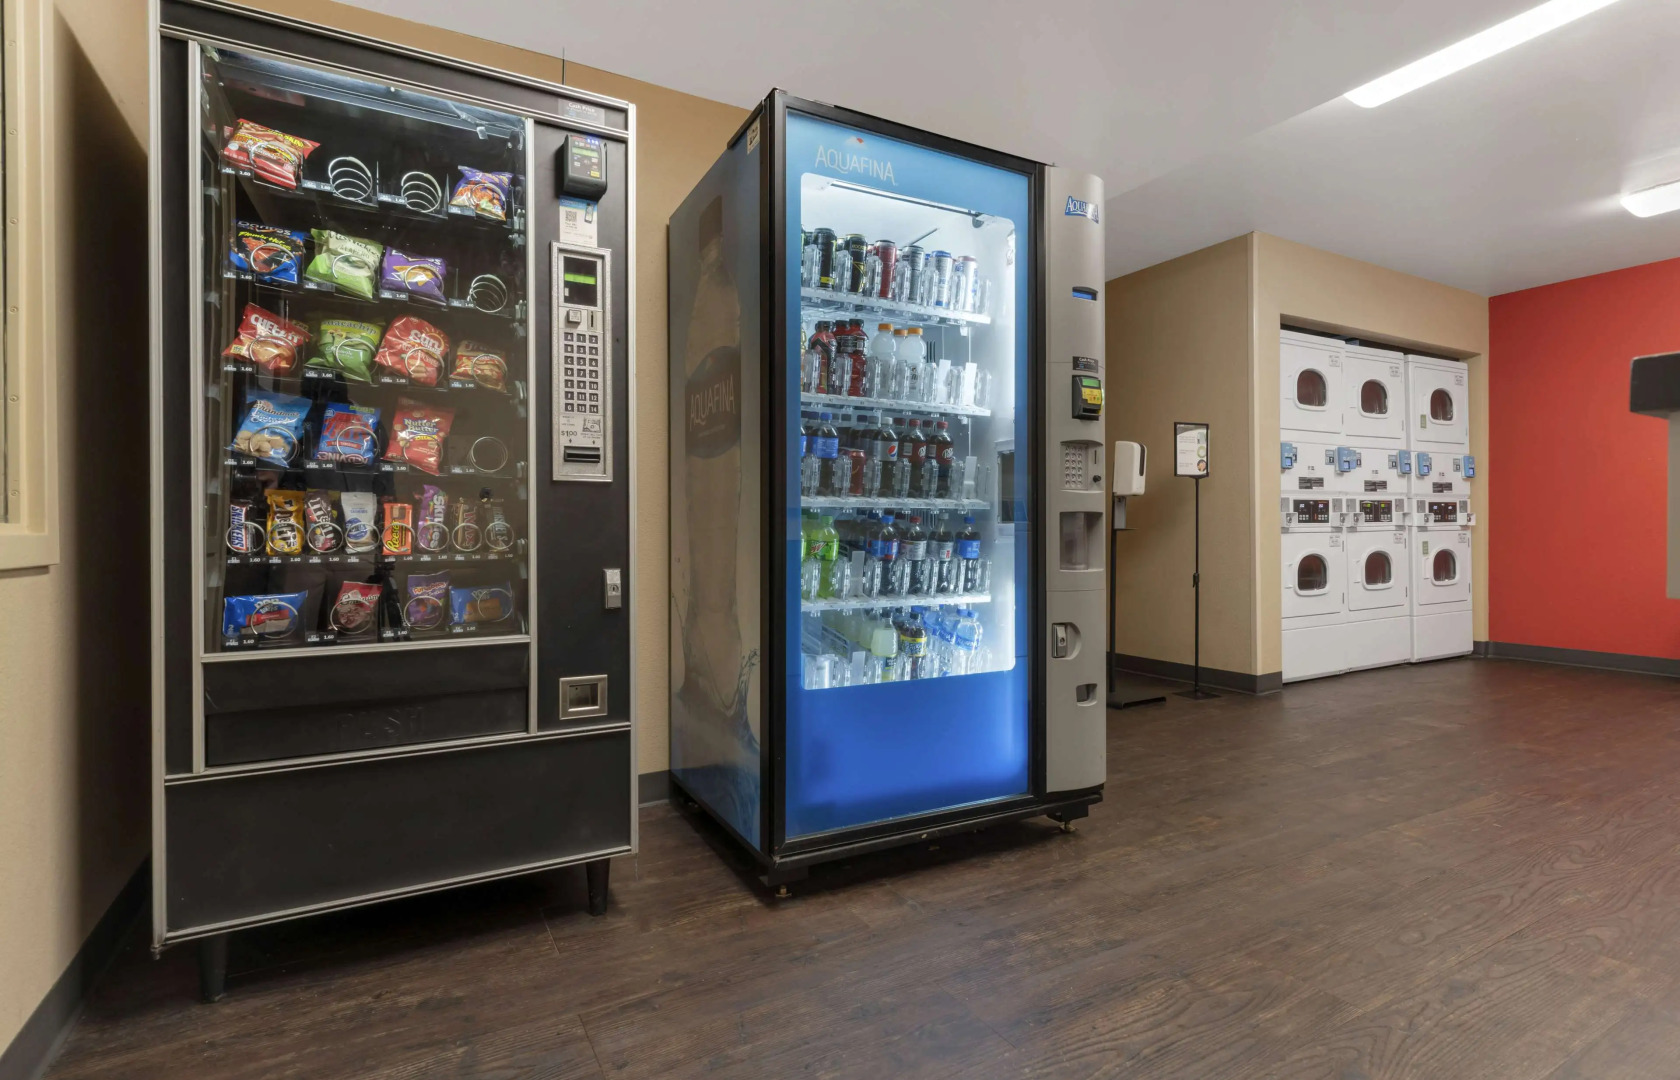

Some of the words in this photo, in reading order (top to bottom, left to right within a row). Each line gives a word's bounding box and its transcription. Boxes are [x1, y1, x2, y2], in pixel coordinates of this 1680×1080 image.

[814, 145, 896, 186] AQUAFINA
[404, 419, 437, 428] Nutter
[689, 374, 736, 432] AQUAFINA
[407, 424, 439, 433] Butter
[231, 506, 244, 548] SNICKERS
